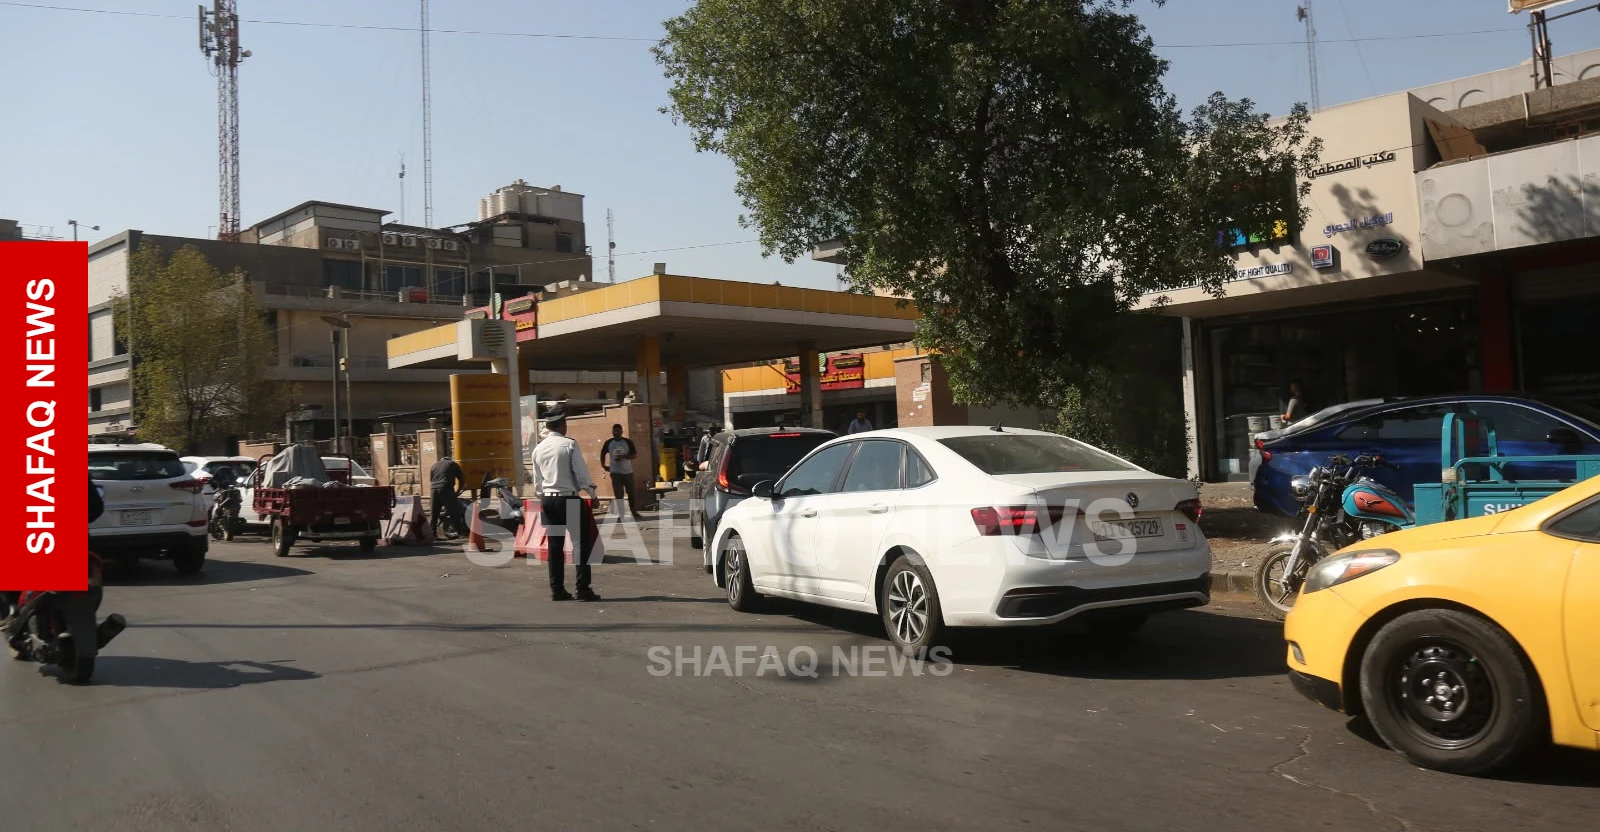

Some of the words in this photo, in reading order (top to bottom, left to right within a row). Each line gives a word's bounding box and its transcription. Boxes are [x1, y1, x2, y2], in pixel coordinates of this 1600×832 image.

[1362, 151, 1395, 169] مكتب
[1323, 218, 1358, 238] الحصري
[1360, 212, 1393, 230] الوكيل
[1239, 270, 1246, 278] OF
[1247, 266, 1264, 277] HIGHT
[1264, 263, 1291, 275] QUALITY
[1128, 520, 1158, 535] 25729
